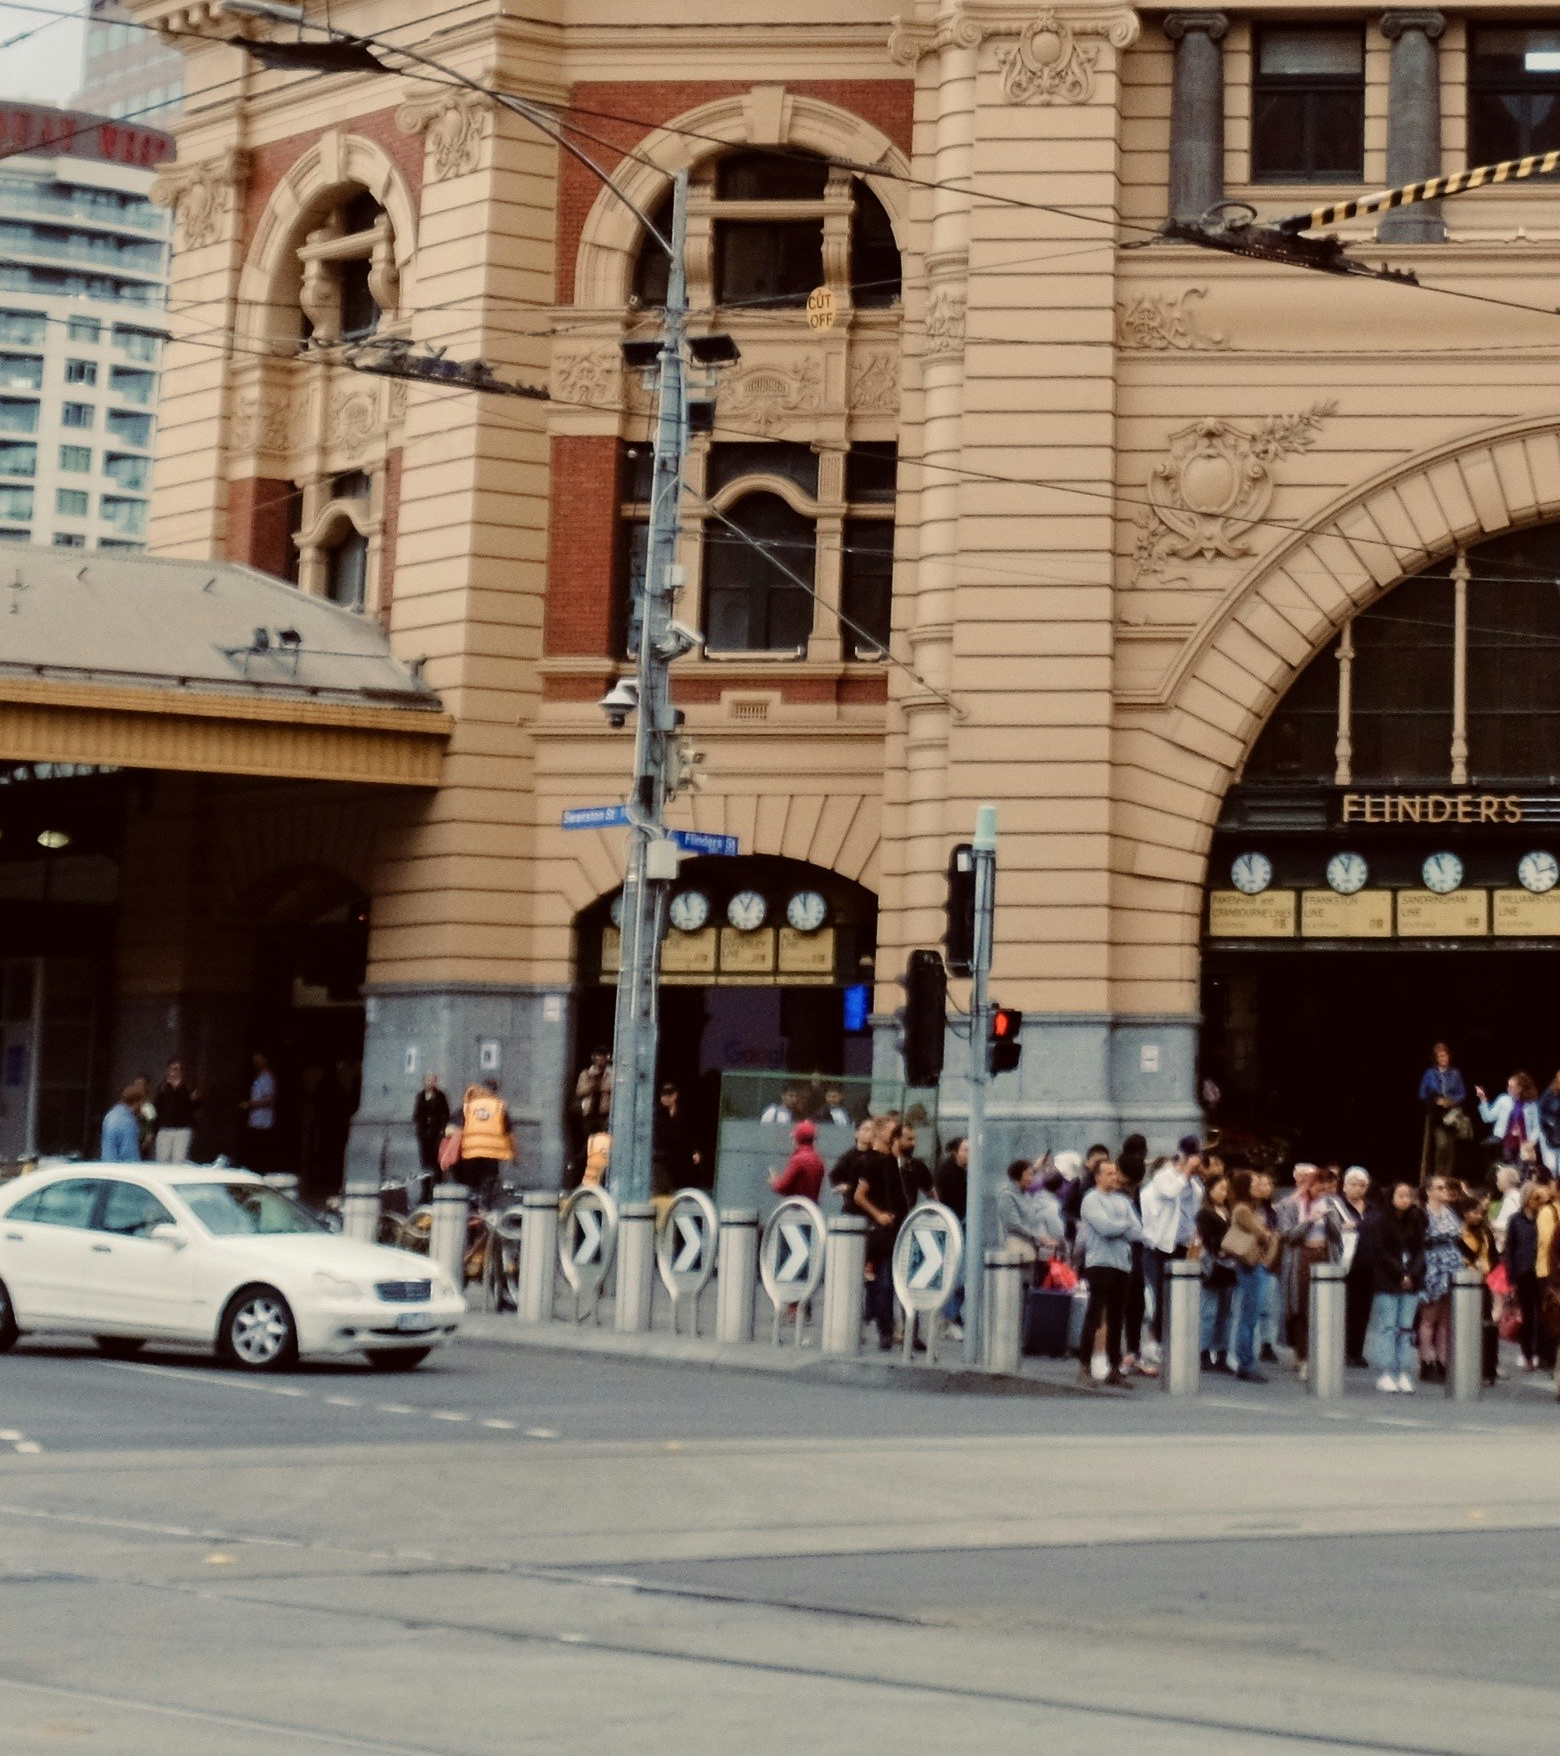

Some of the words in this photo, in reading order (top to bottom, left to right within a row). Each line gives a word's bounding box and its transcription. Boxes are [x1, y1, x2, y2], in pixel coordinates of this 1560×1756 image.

[809, 294, 832, 310] CUT
[811, 313, 833, 329] OFF
[1342, 794, 1523, 824] FLINDERS
[684, 831, 723, 848] Flinders
[726, 836, 736, 849] St
